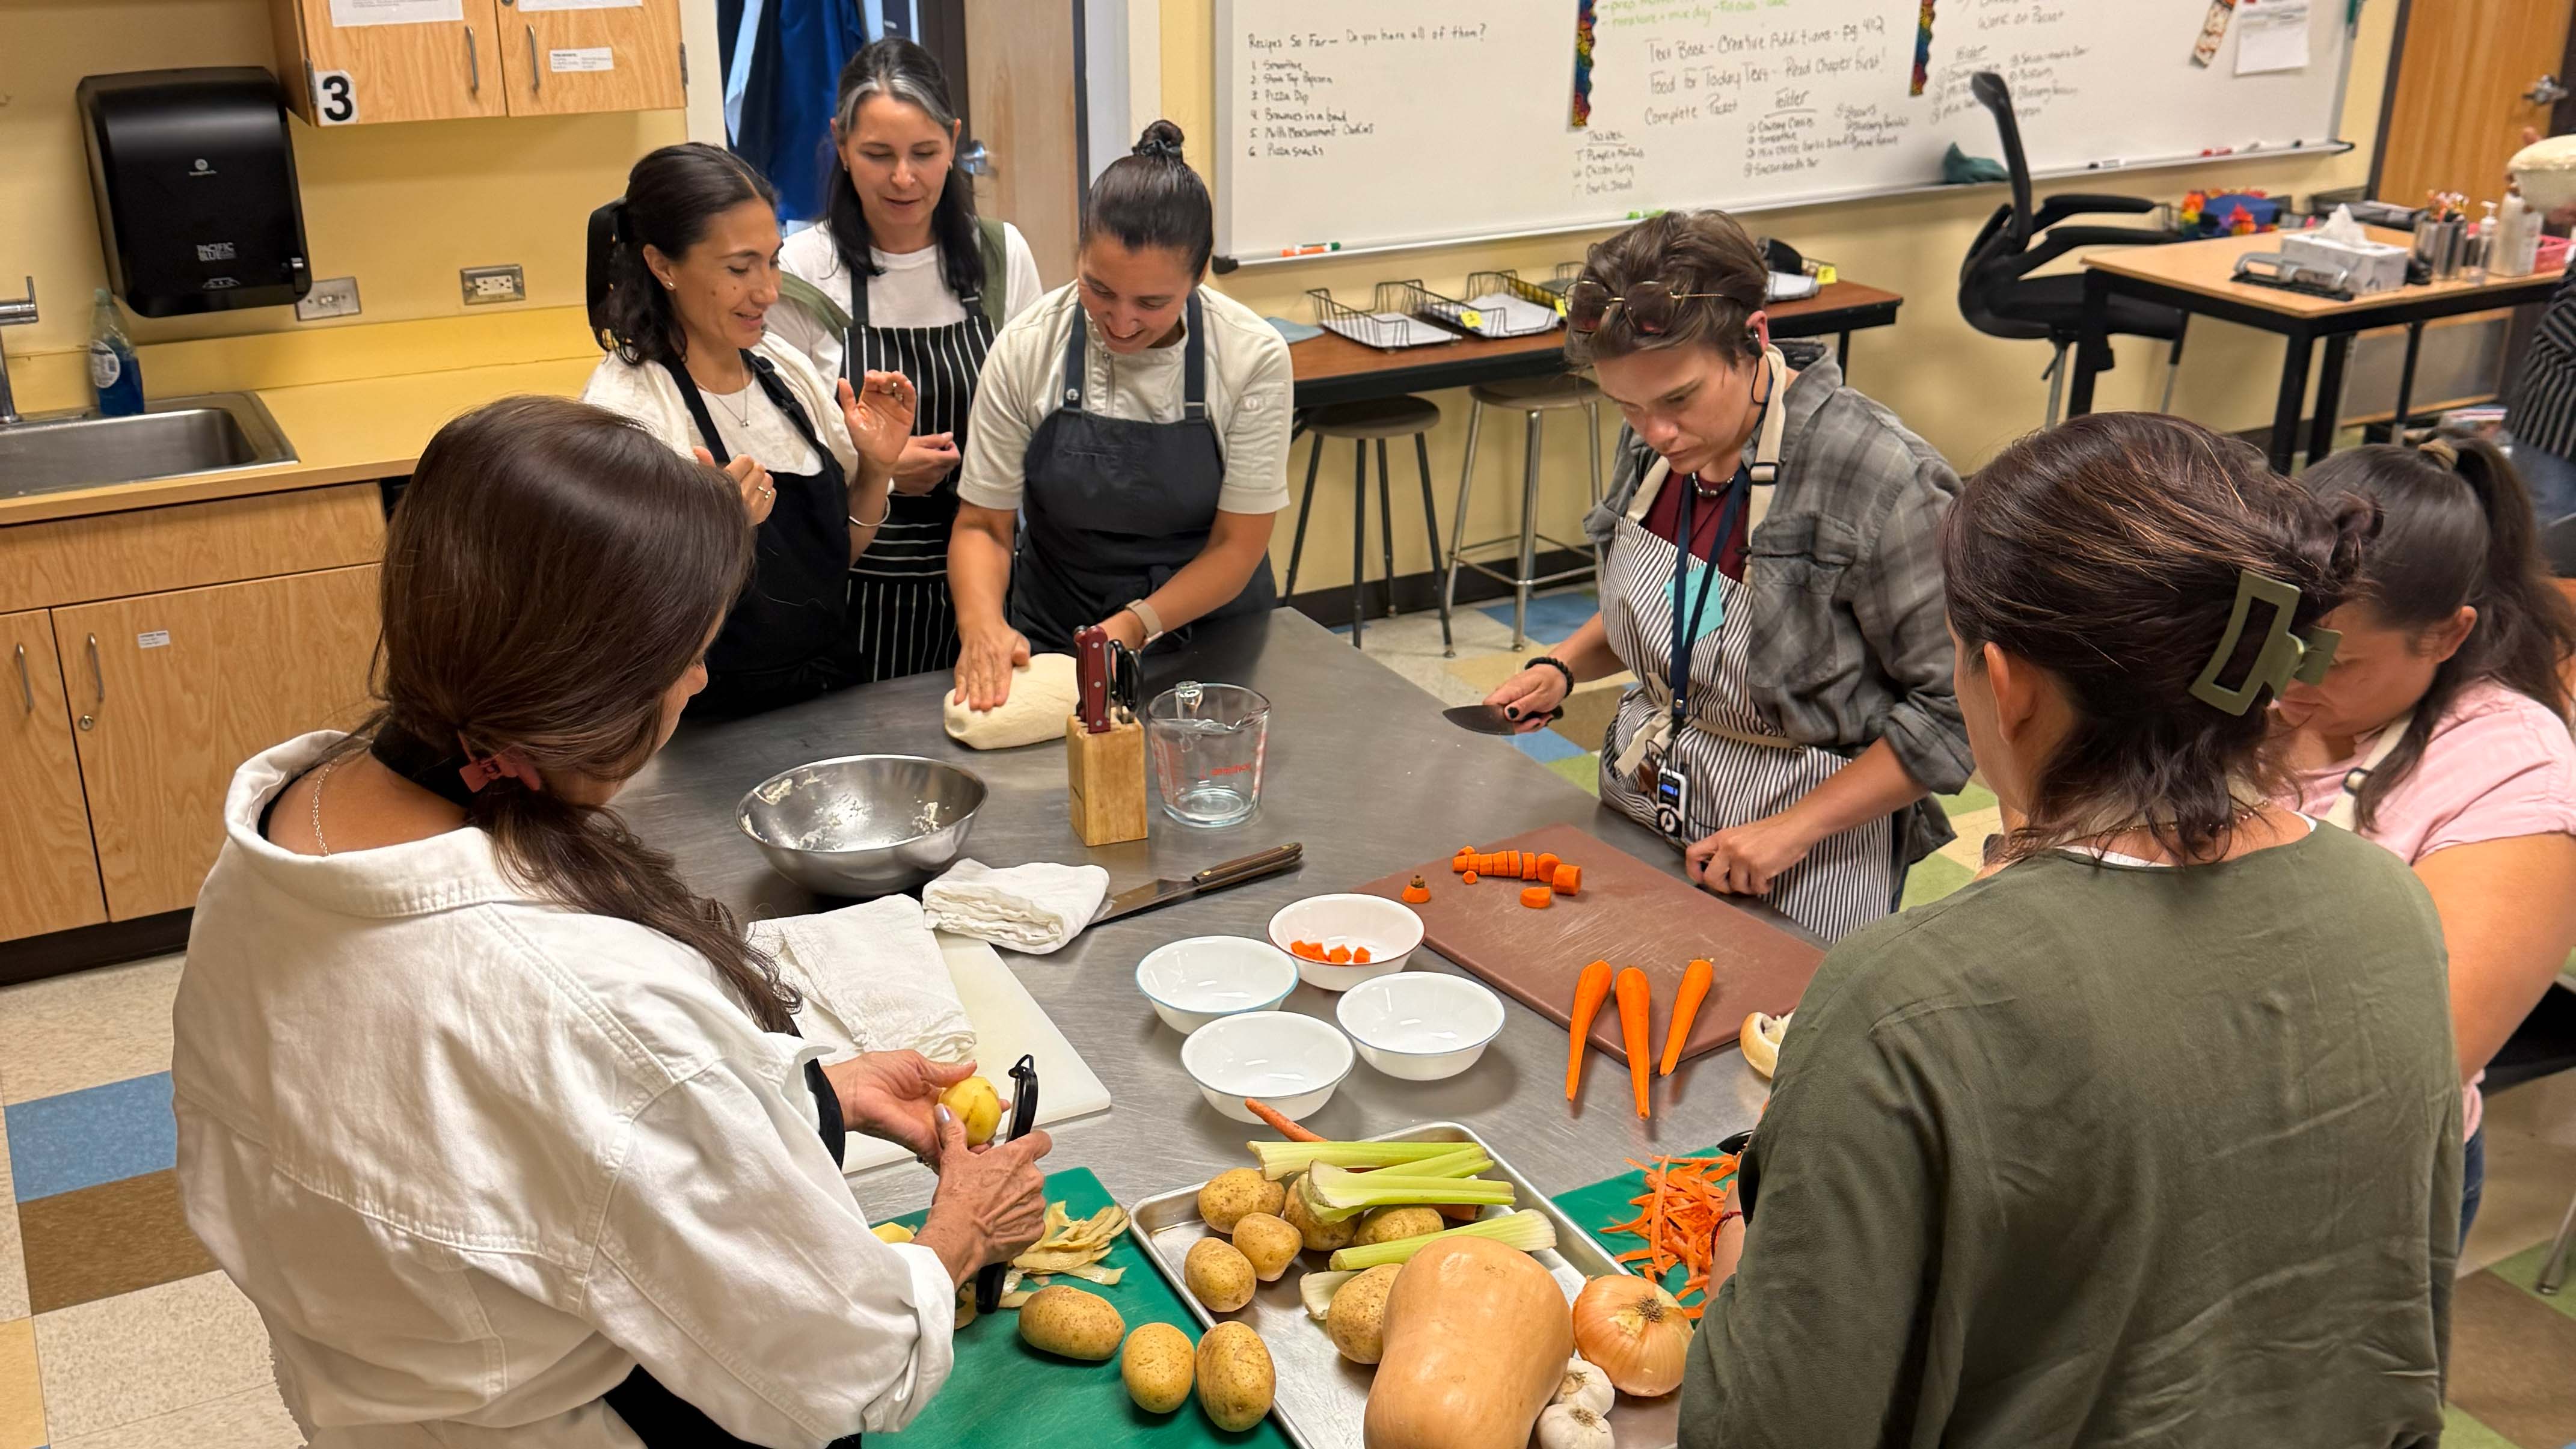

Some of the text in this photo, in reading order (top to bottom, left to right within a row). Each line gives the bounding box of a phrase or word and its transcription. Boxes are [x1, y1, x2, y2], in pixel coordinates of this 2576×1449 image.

[1290, 34, 1302, 48] So
[1346, 28, 1358, 43] Do
[1411, 25, 1425, 40] all
[322, 75, 354, 122] 3
[197, 242, 234, 252] PACIFIC
